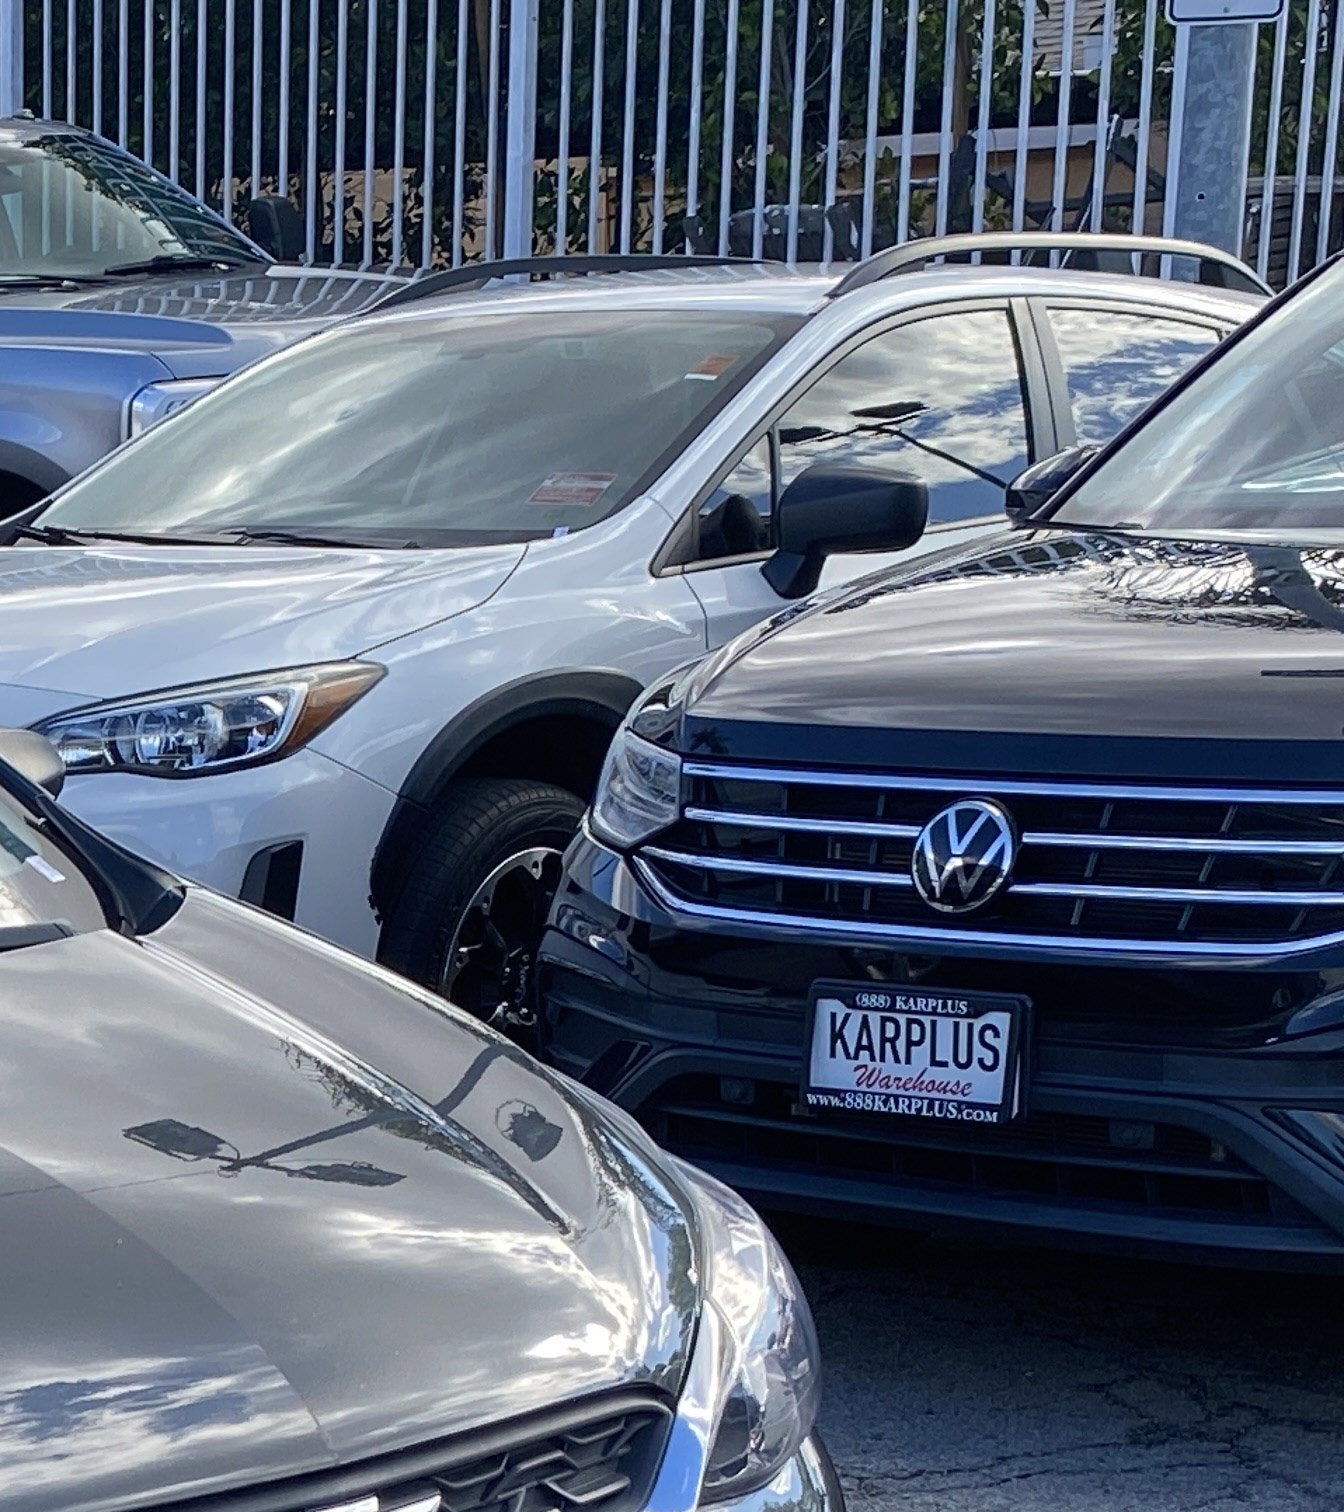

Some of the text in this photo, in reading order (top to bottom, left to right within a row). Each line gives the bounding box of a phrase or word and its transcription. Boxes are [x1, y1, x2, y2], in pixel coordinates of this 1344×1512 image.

[855, 993, 968, 1015] (888) KARPLUS
[829, 1011, 1001, 1072] KARPLUS
[853, 1064, 973, 1096] Warehouse
